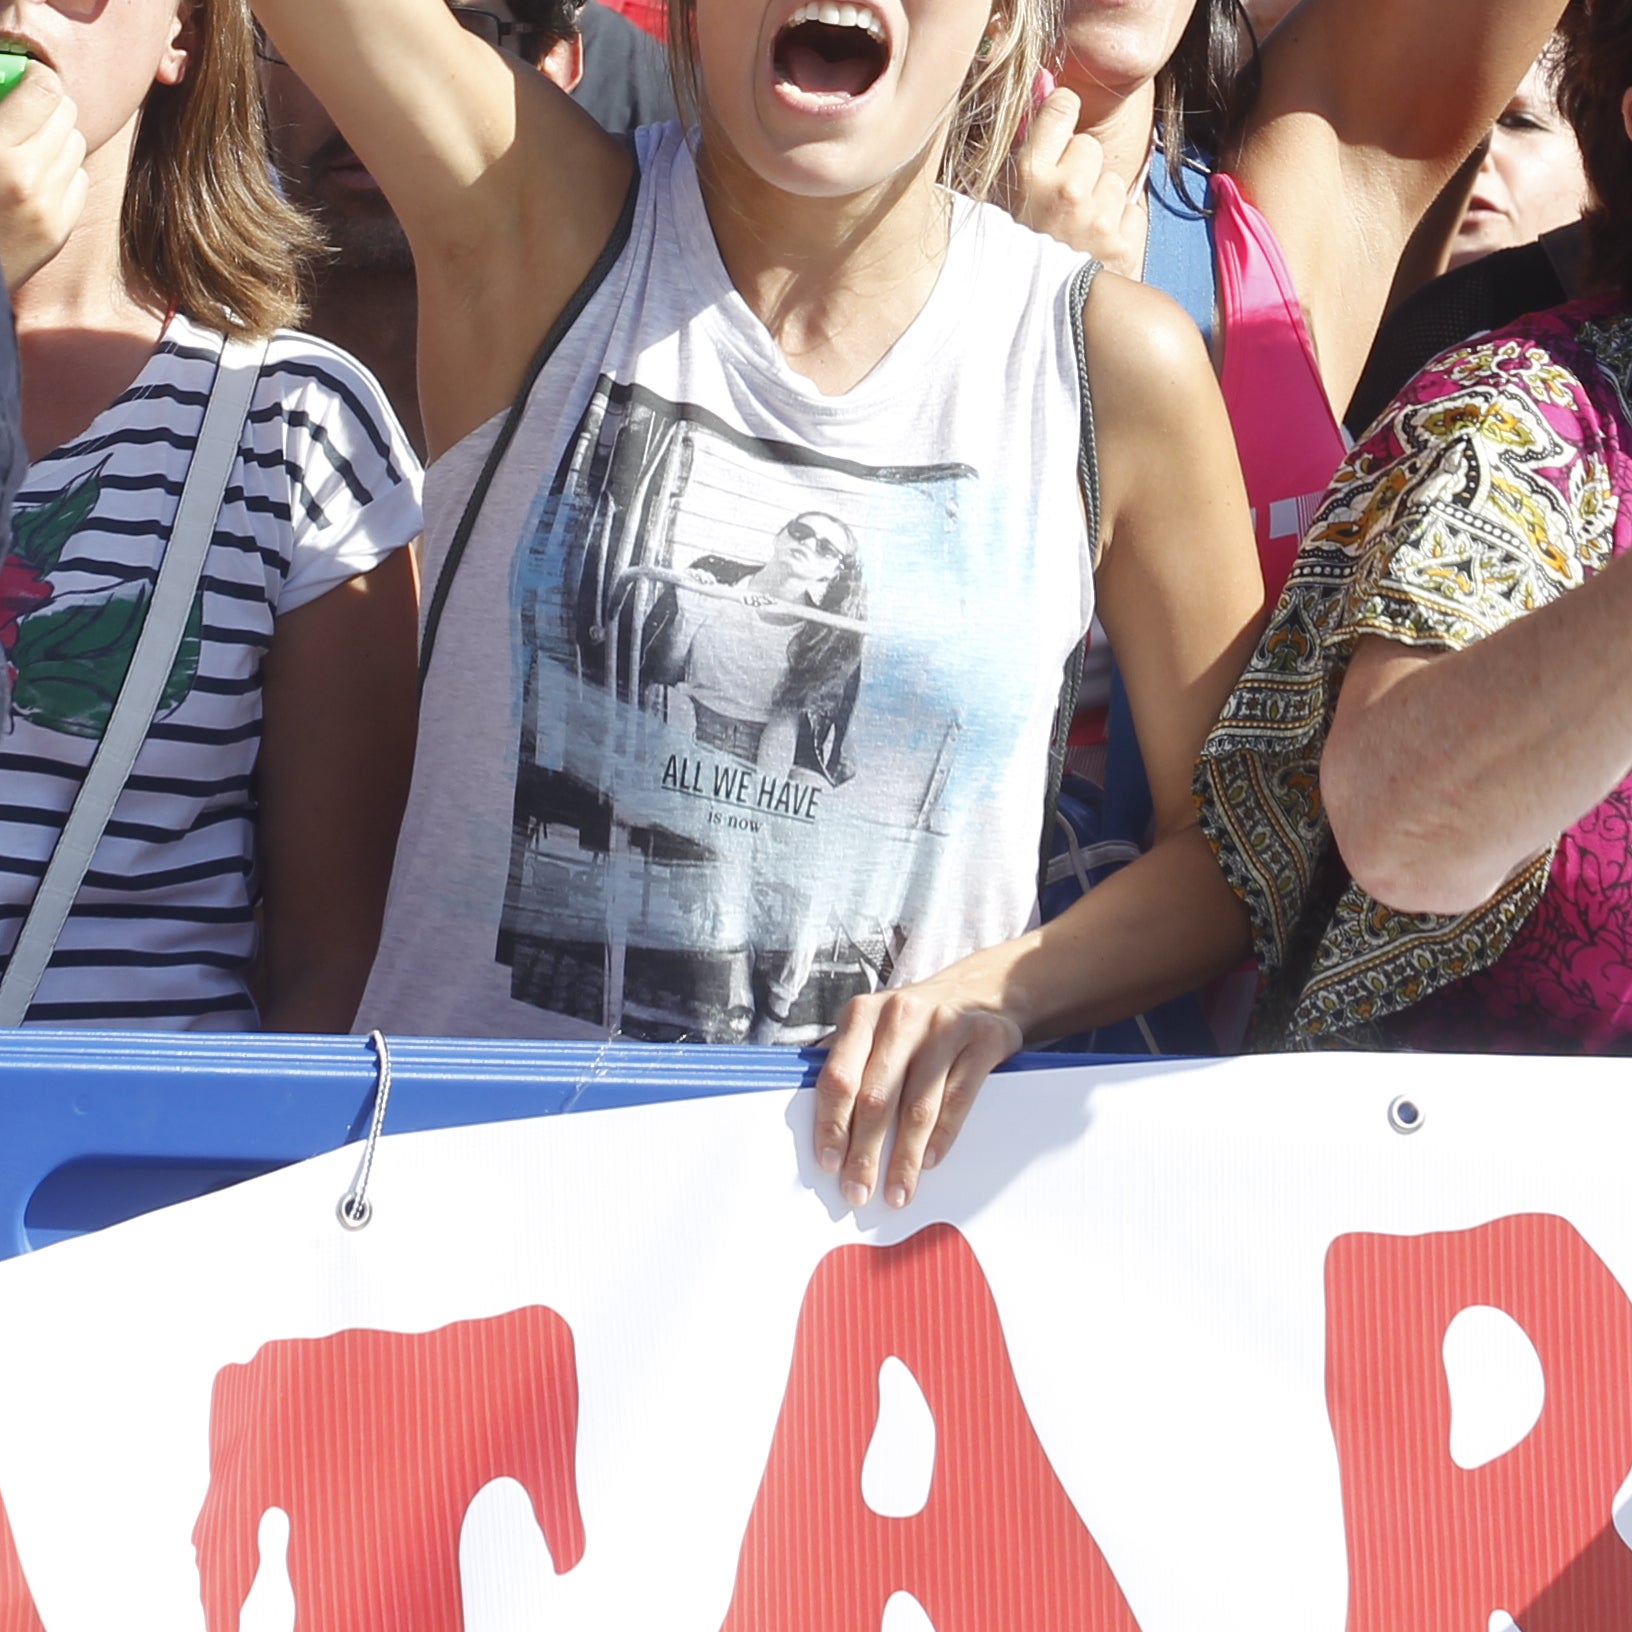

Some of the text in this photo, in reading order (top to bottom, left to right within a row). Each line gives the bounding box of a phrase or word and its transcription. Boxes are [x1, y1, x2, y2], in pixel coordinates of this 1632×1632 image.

[662, 754, 822, 819] ALL WE HAVE
[708, 805, 763, 833] is now
